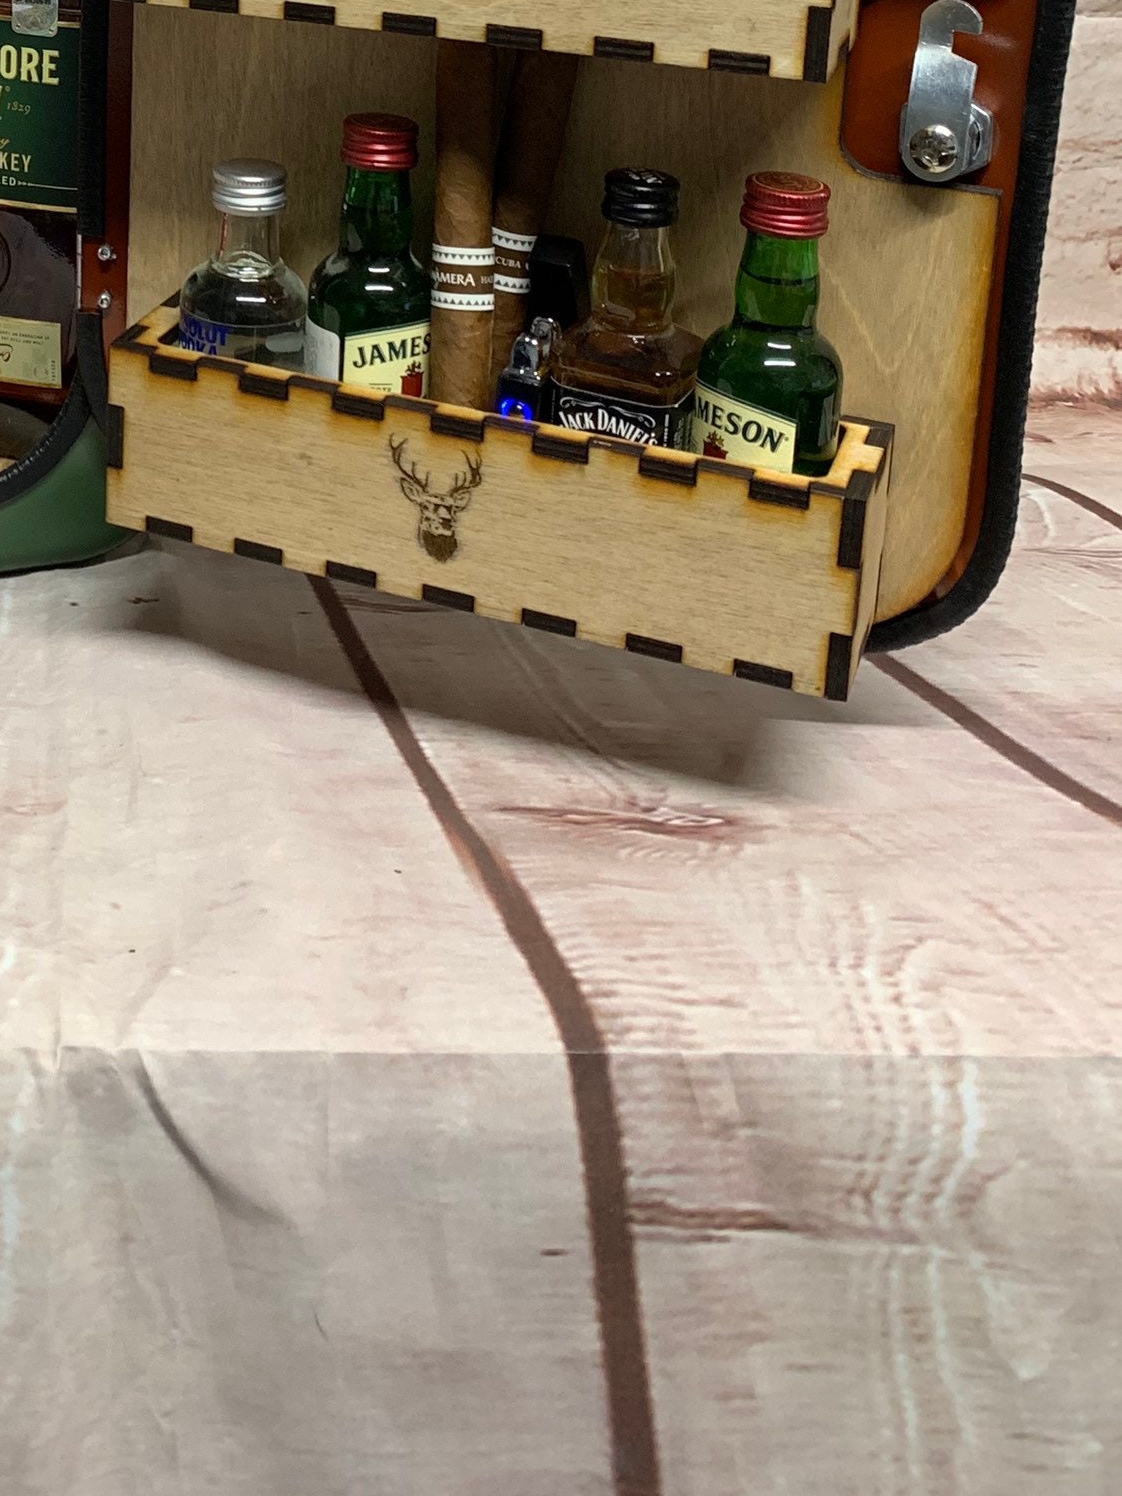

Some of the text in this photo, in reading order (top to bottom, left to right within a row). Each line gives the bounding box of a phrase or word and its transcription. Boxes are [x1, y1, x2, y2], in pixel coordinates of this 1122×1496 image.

[6, 100, 31, 116] 1829
[495, 256, 521, 269] CUBA
[558, 410, 597, 431] JACK
